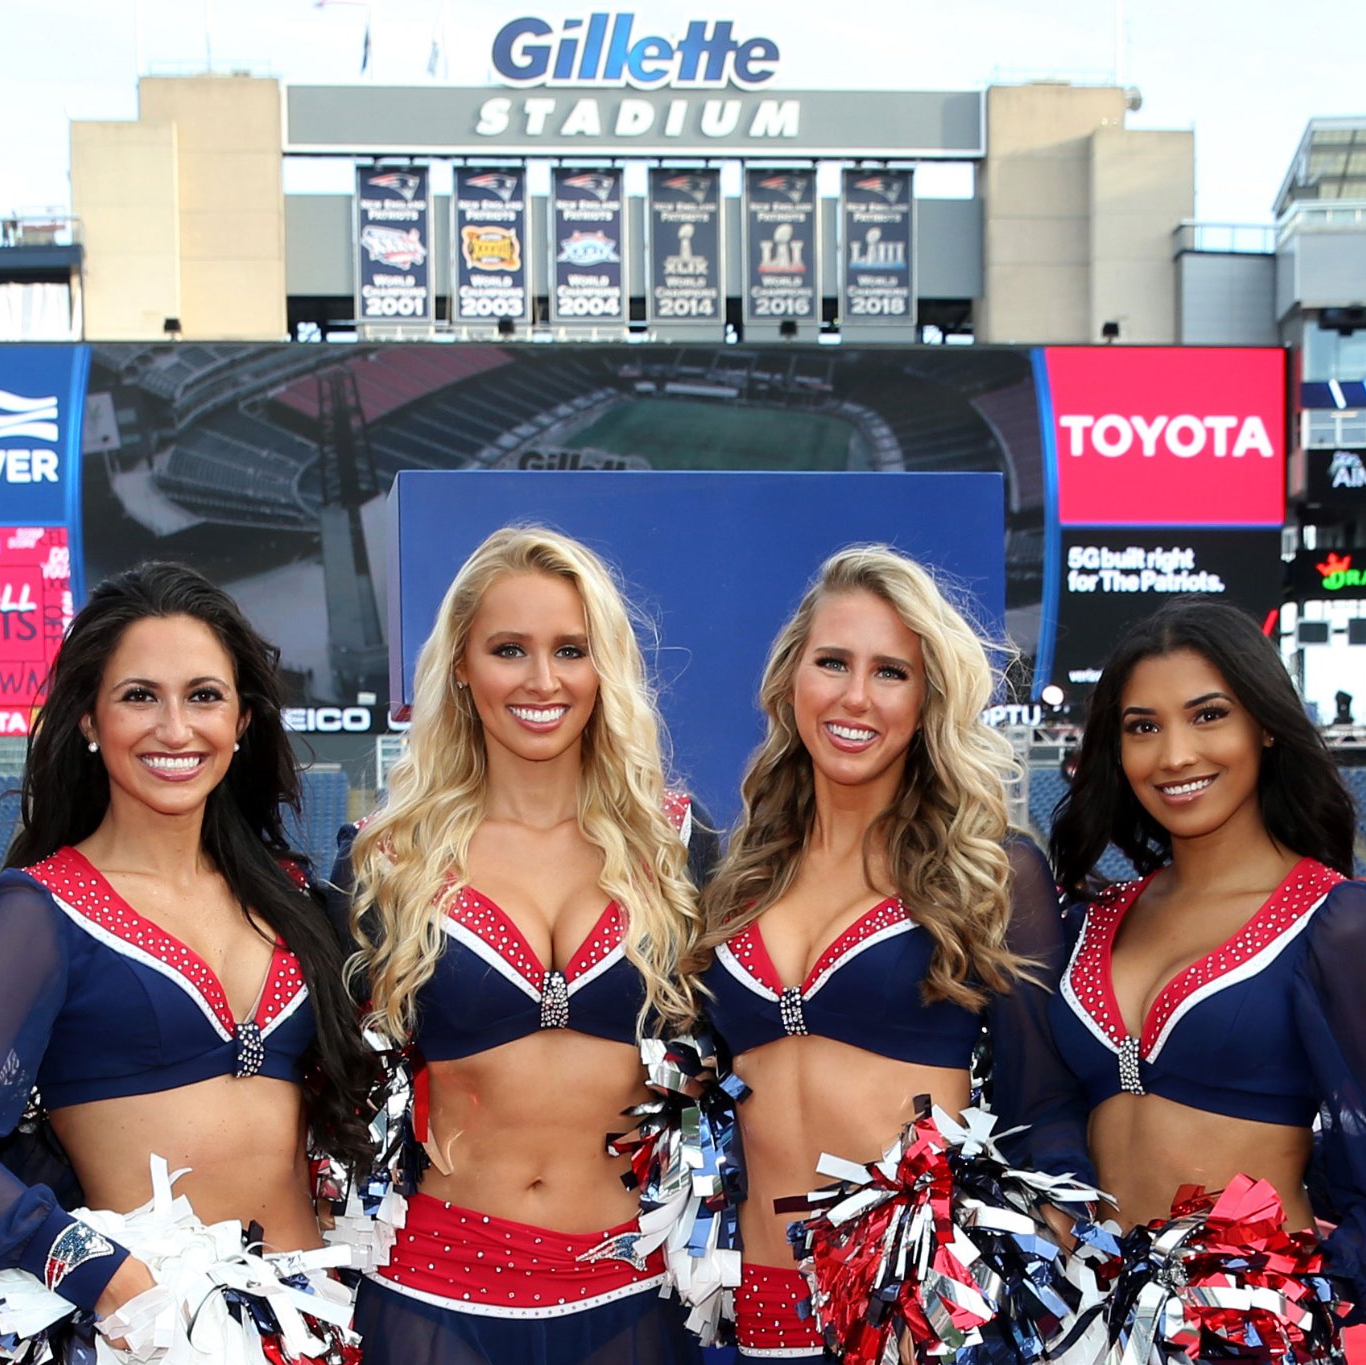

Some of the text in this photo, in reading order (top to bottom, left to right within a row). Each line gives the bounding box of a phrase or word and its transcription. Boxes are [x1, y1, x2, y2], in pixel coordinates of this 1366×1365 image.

[492, 12, 781, 84] Gillette
[474, 97, 801, 138] STADIUM
[664, 255, 708, 275] XLIX
[366, 298, 424, 316] 2001
[461, 298, 524, 316] 2003
[558, 298, 620, 316] 2004
[659, 298, 714, 316] 2014
[755, 298, 810, 316] 2016
[851, 298, 906, 316] 2018
[1059, 414, 1274, 458] TOYOTA
[1068, 547, 1195, 574] 5G built right
[1068, 570, 1226, 592] for The Patriots.
